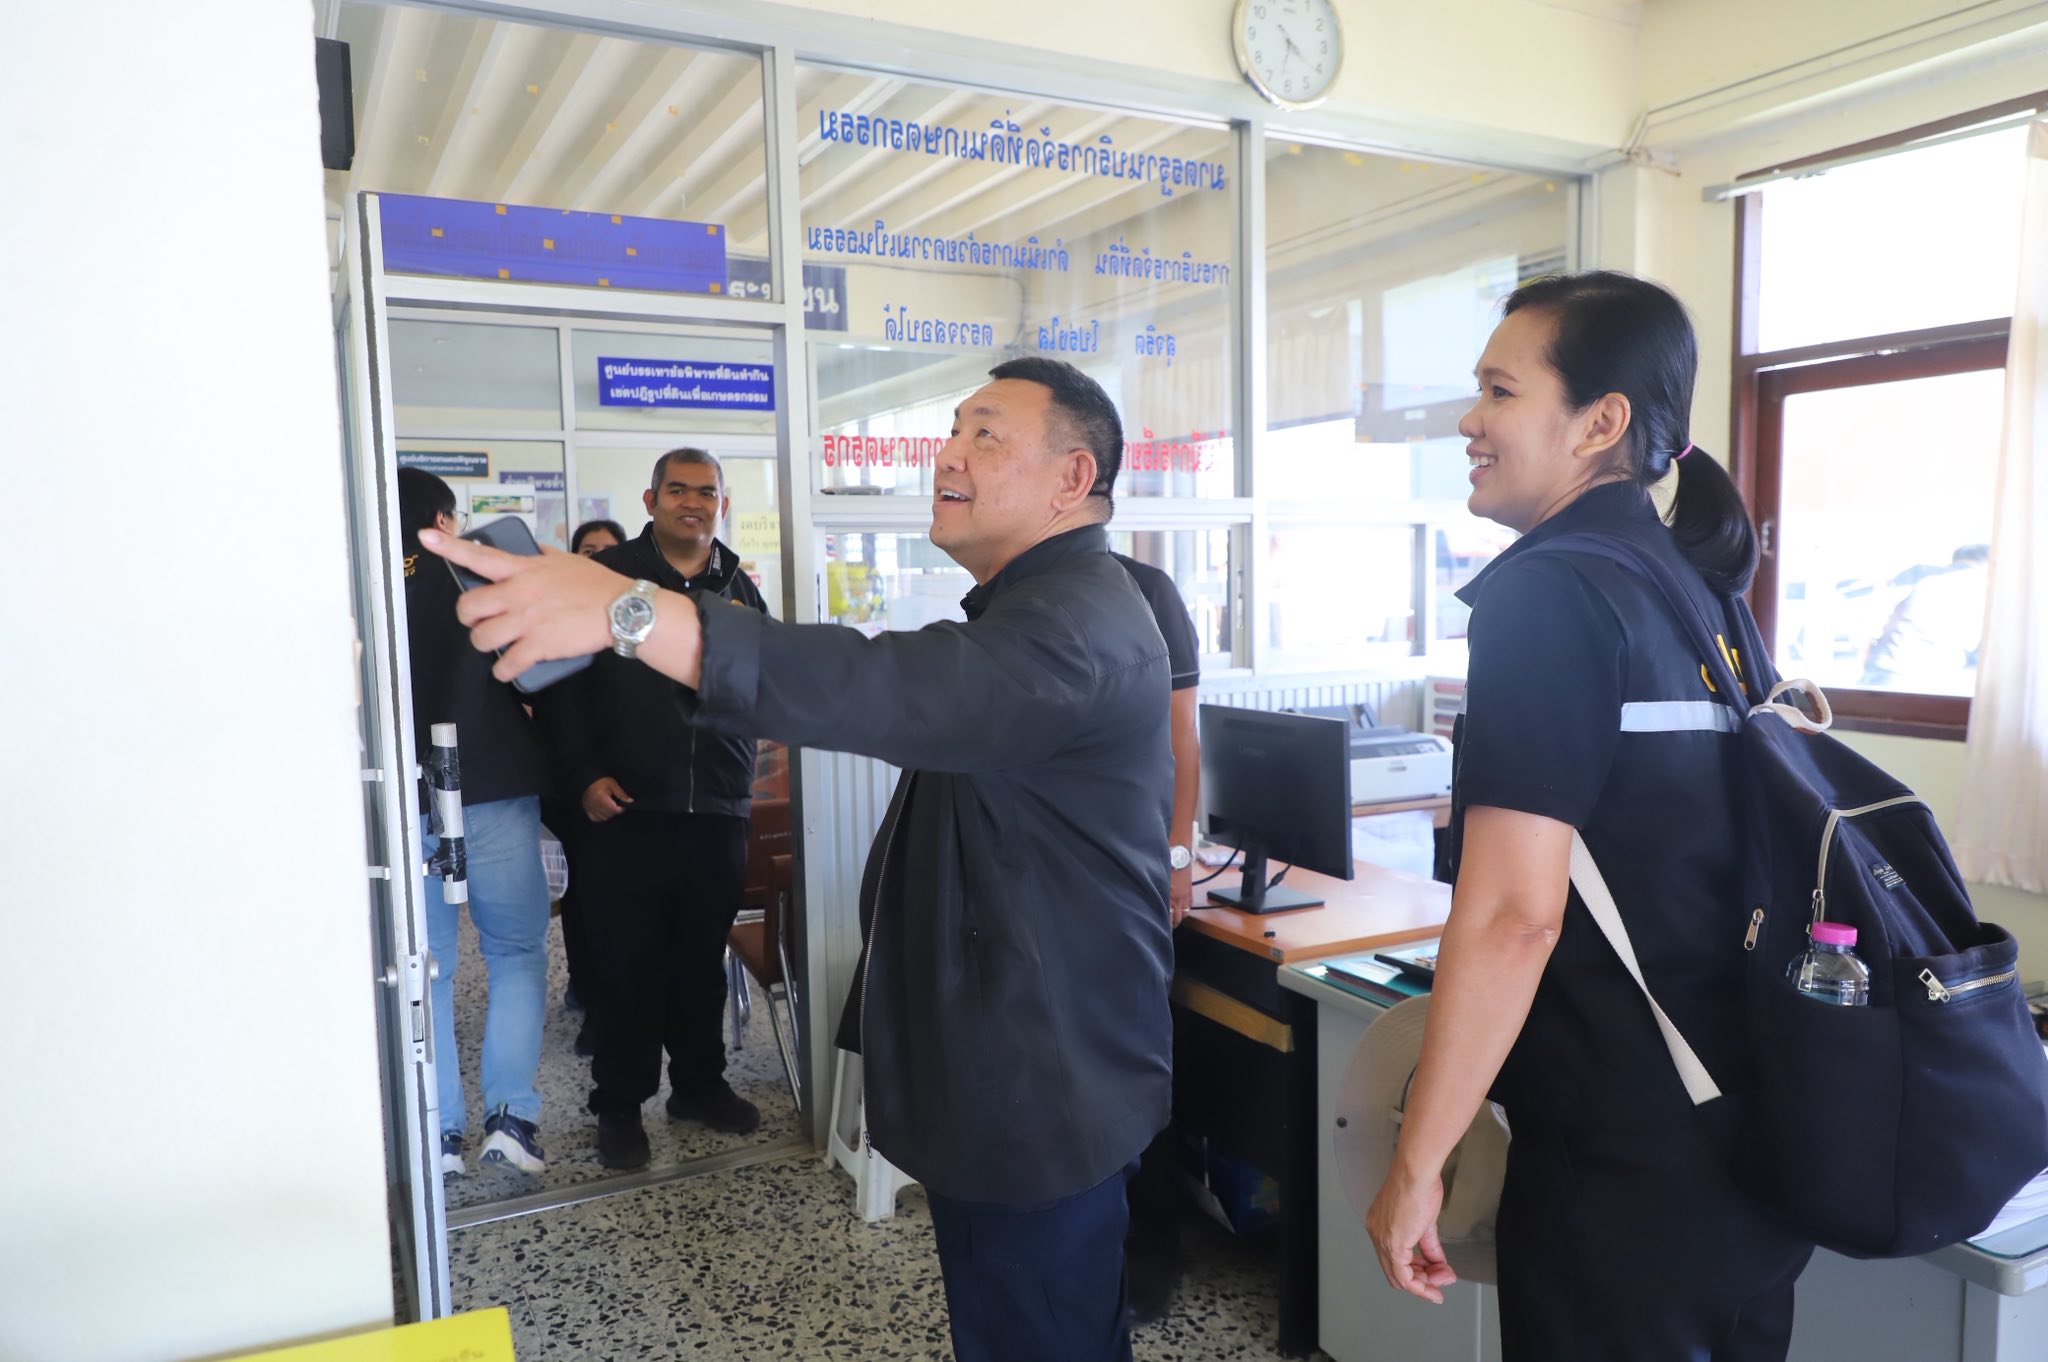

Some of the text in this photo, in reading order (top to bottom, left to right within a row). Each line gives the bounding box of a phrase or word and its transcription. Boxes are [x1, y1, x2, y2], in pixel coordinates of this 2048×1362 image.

[1253, 5, 1266, 20] 10
[1315, 18, 1324, 32] 2
[1248, 26, 1256, 40] 9
[1320, 40, 1328, 54] 3
[1255, 50, 1262, 64] 8
[1266, 69, 1274, 82] 7
[1314, 64, 1322, 75] 4
[1284, 80, 1292, 93] 6
[1302, 76, 1310, 89] 5
